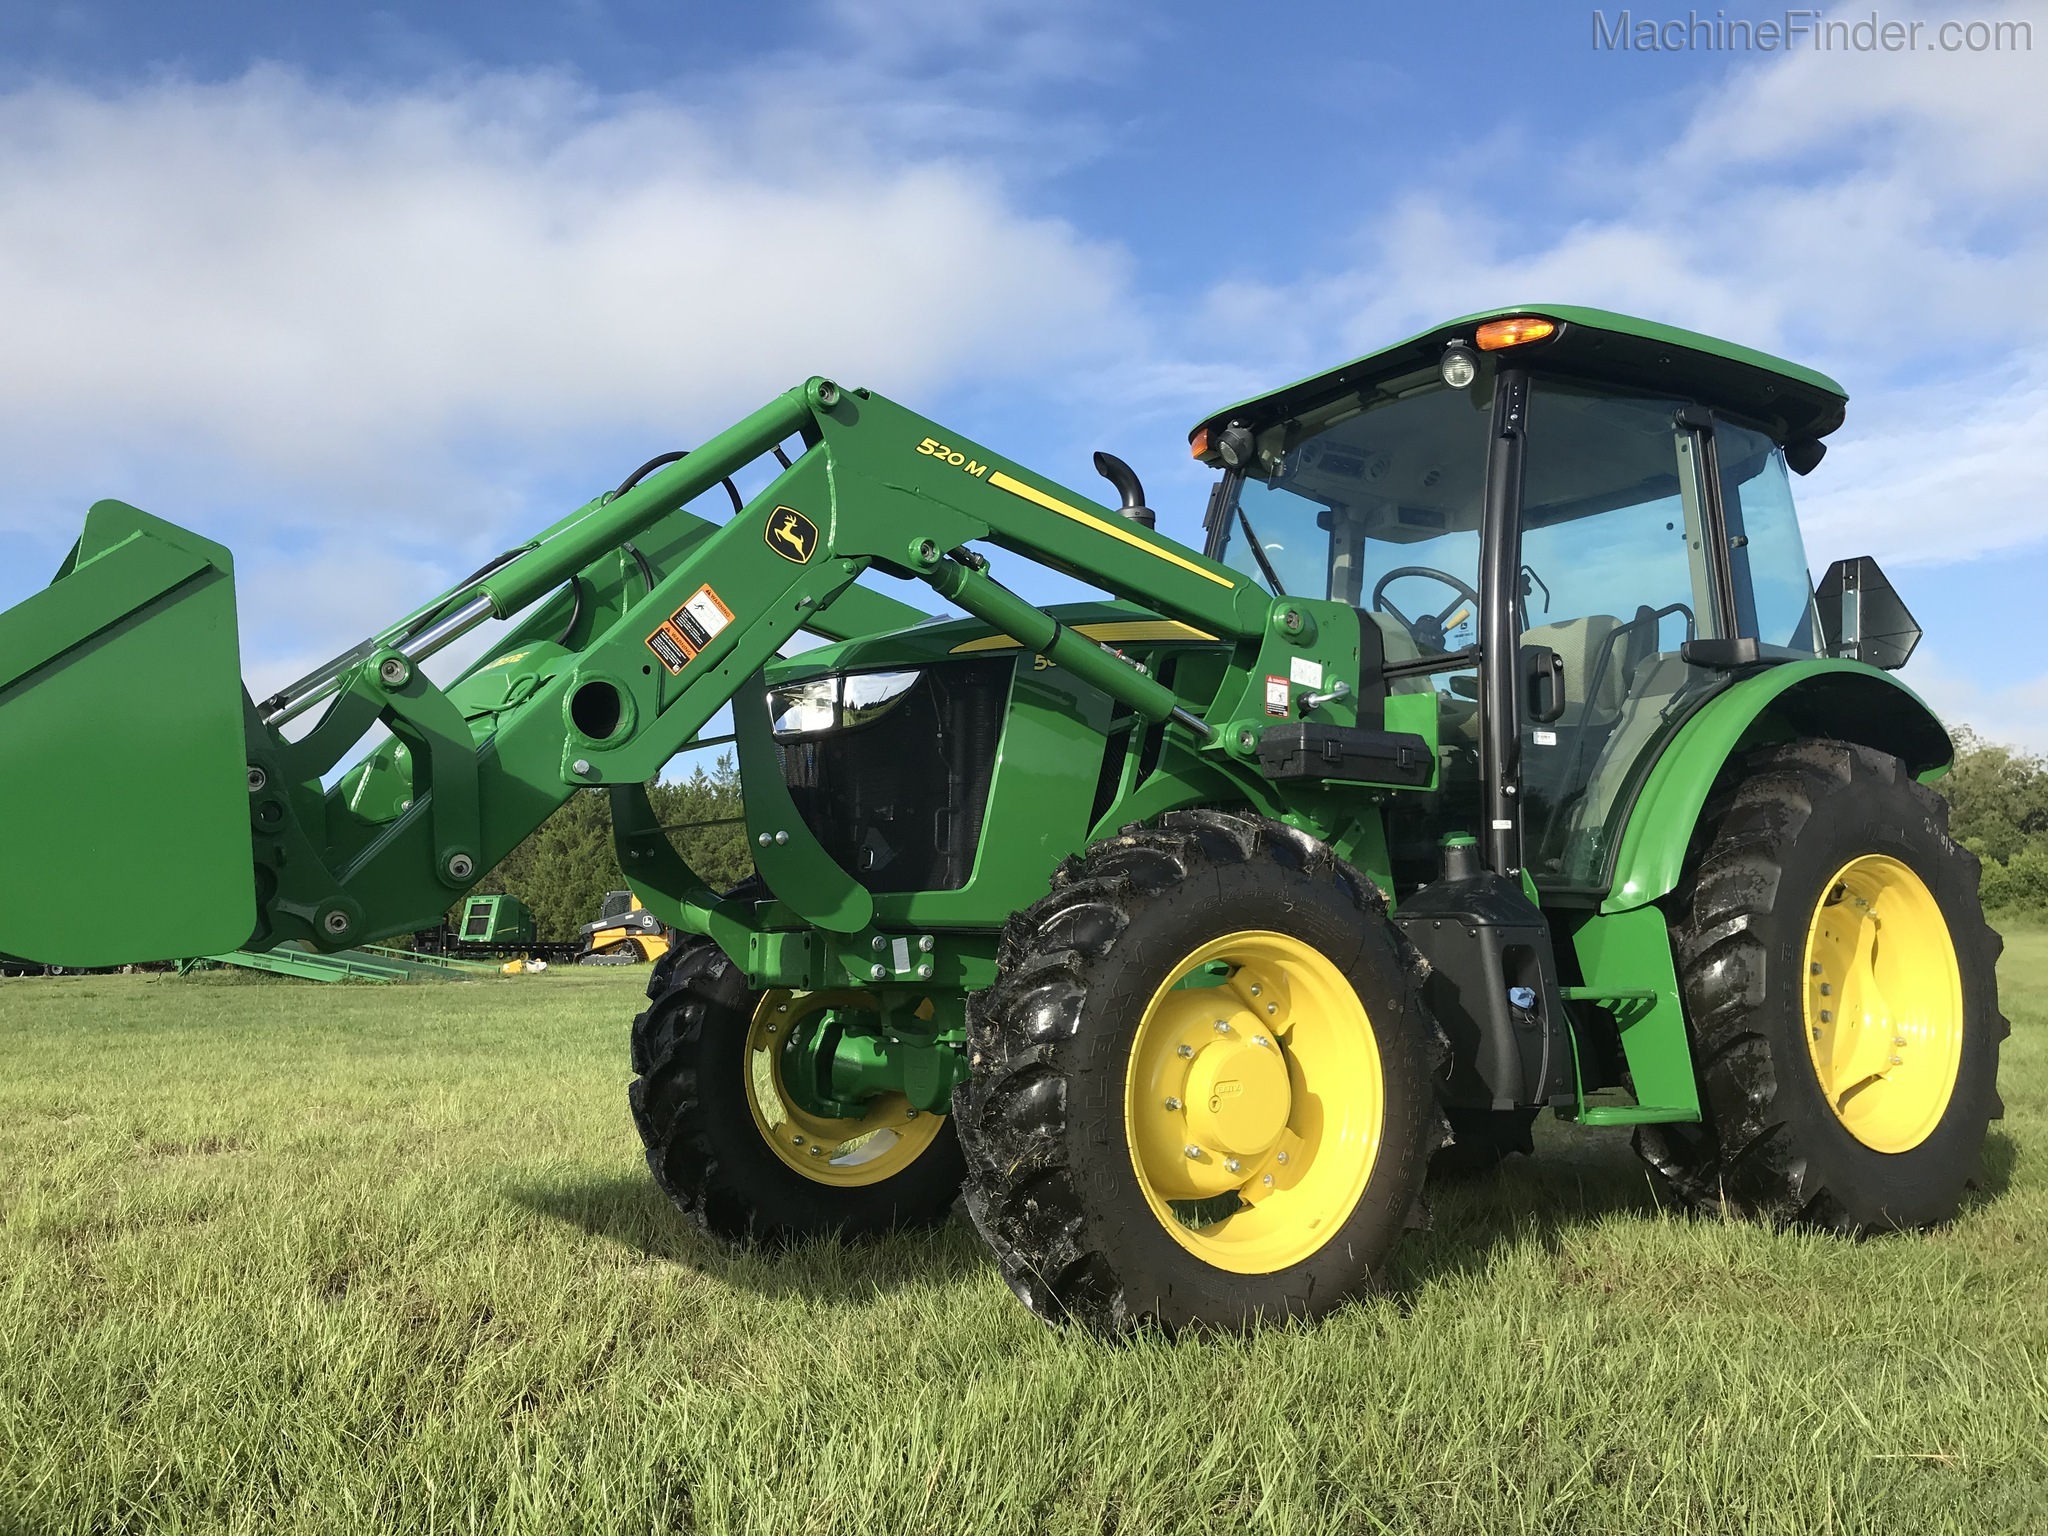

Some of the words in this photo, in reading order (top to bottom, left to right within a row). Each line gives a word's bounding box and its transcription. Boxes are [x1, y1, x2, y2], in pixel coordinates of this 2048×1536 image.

[915, 436, 966, 467] 520
[962, 459, 988, 478] M
[710, 593, 731, 618] WARNING
[671, 631, 692, 656] WARNING
